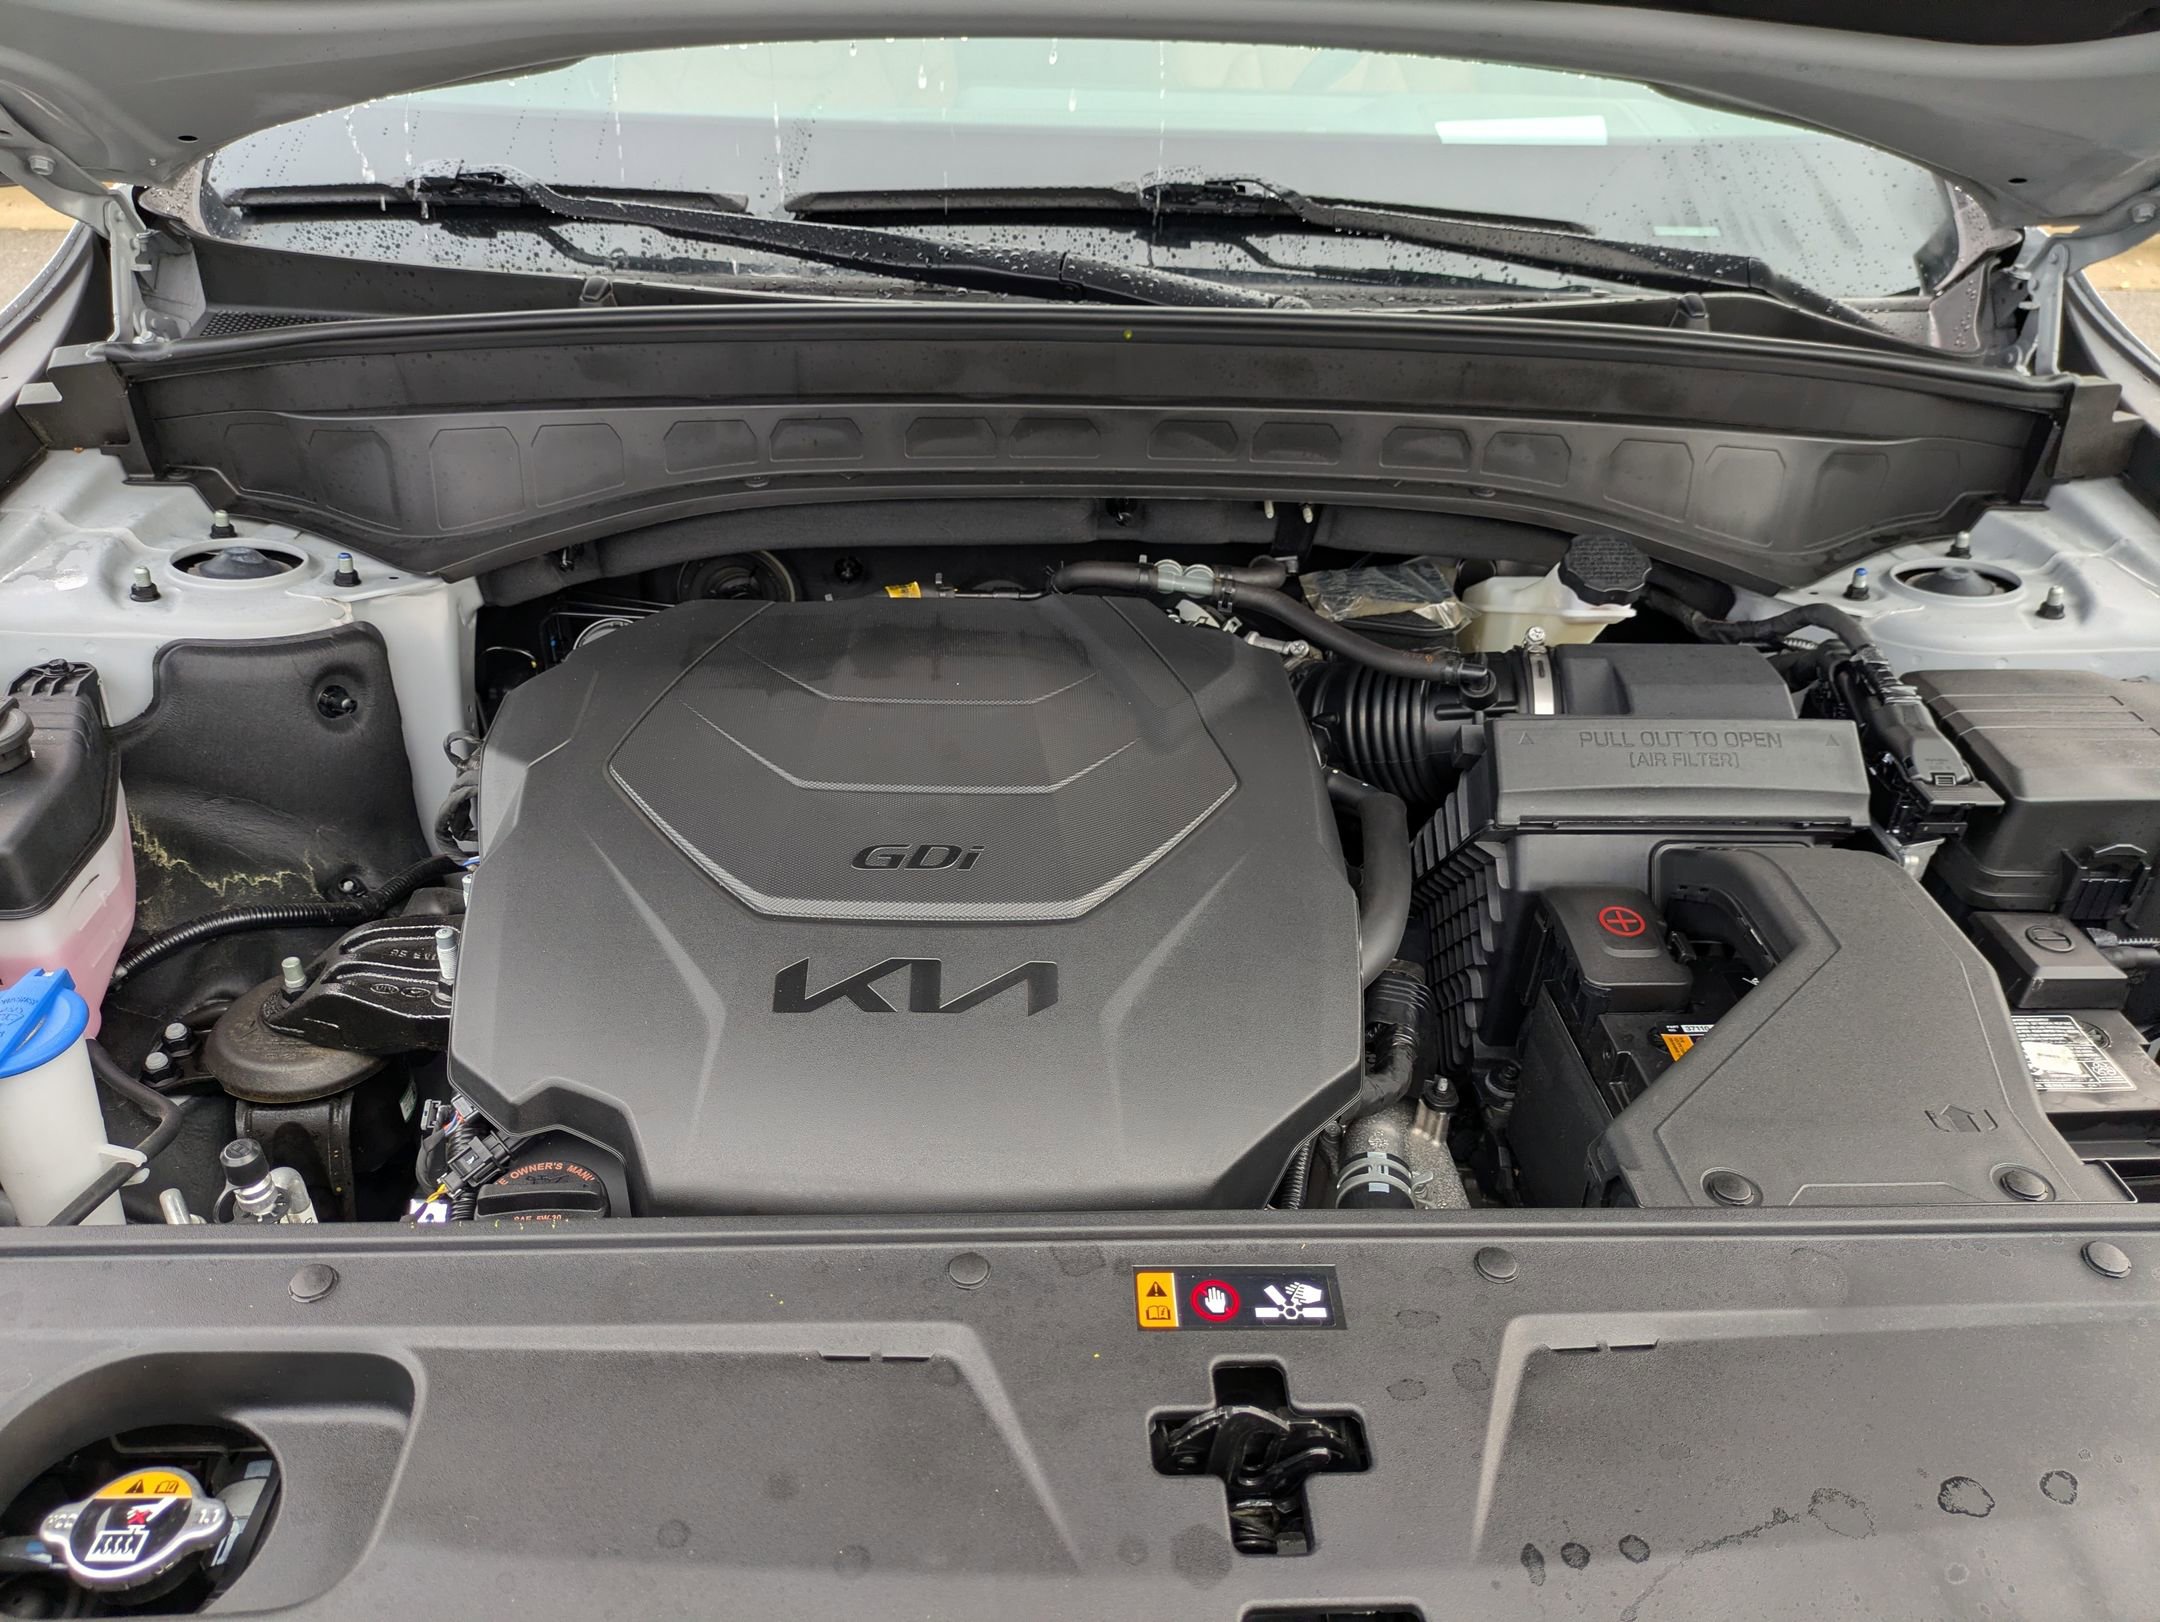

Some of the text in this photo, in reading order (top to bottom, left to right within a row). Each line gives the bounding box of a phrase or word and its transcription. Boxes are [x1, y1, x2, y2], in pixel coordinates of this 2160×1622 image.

[1579, 731, 1783, 748] PULL OUT TO OPEN
[851, 844, 985, 871] GDi
[772, 957, 1058, 1016] KIA
[510, 1162, 563, 1179] OWNER'S
